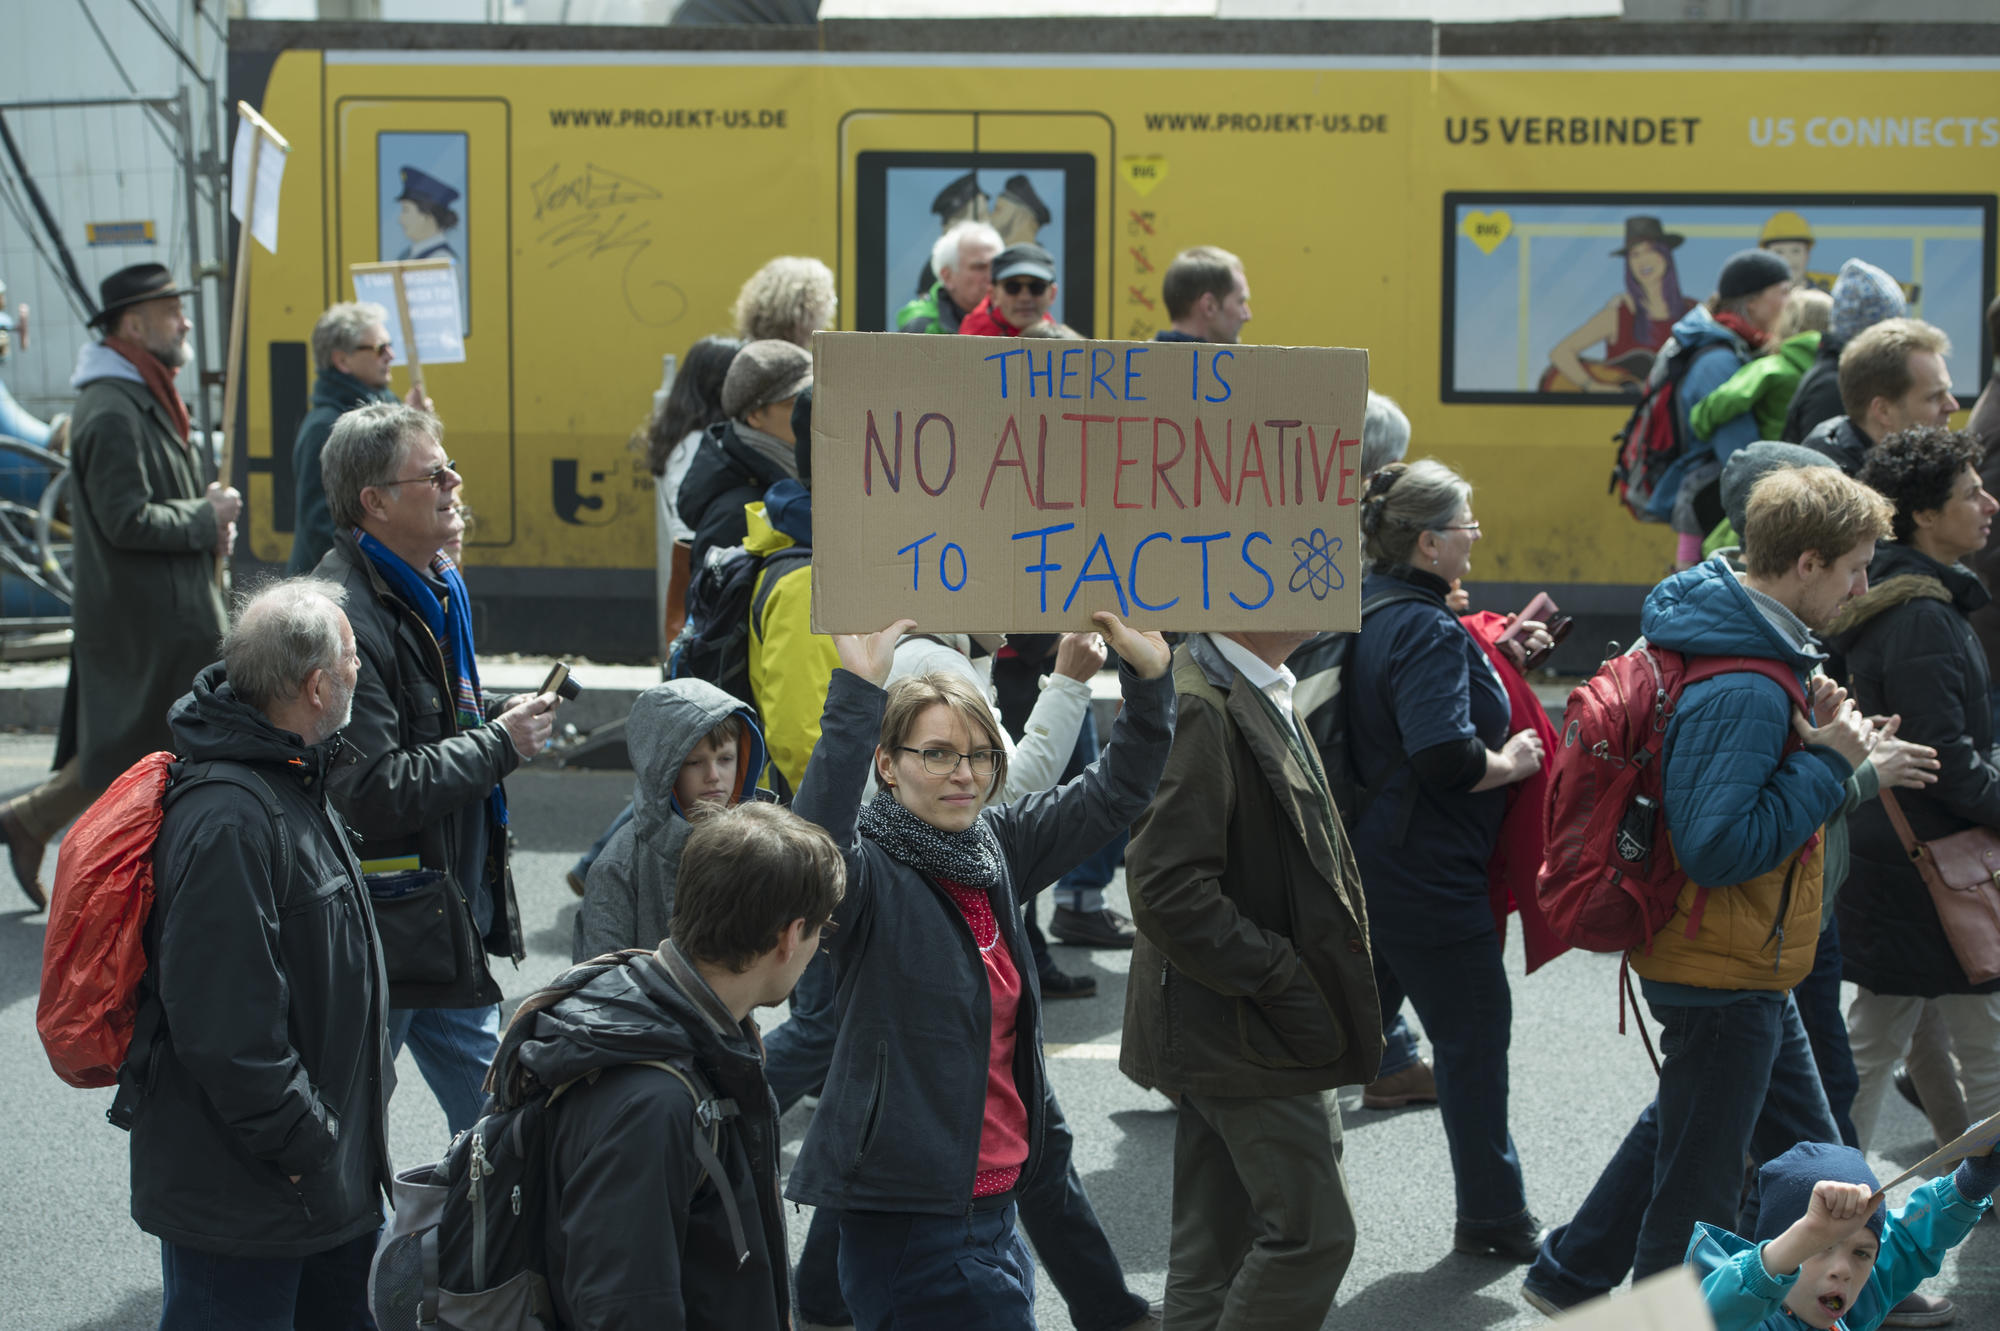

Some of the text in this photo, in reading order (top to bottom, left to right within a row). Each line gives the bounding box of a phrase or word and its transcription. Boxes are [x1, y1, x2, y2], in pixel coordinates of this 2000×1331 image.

[1445, 117, 1701, 145] U5 VERBINDET
[1748, 117, 2000, 148] U5 CONNECTS
[984, 348, 1235, 403] THERE IS
[864, 409, 1361, 510] NO ALTERNATIVE
[897, 522, 1275, 618] TO FACTS
